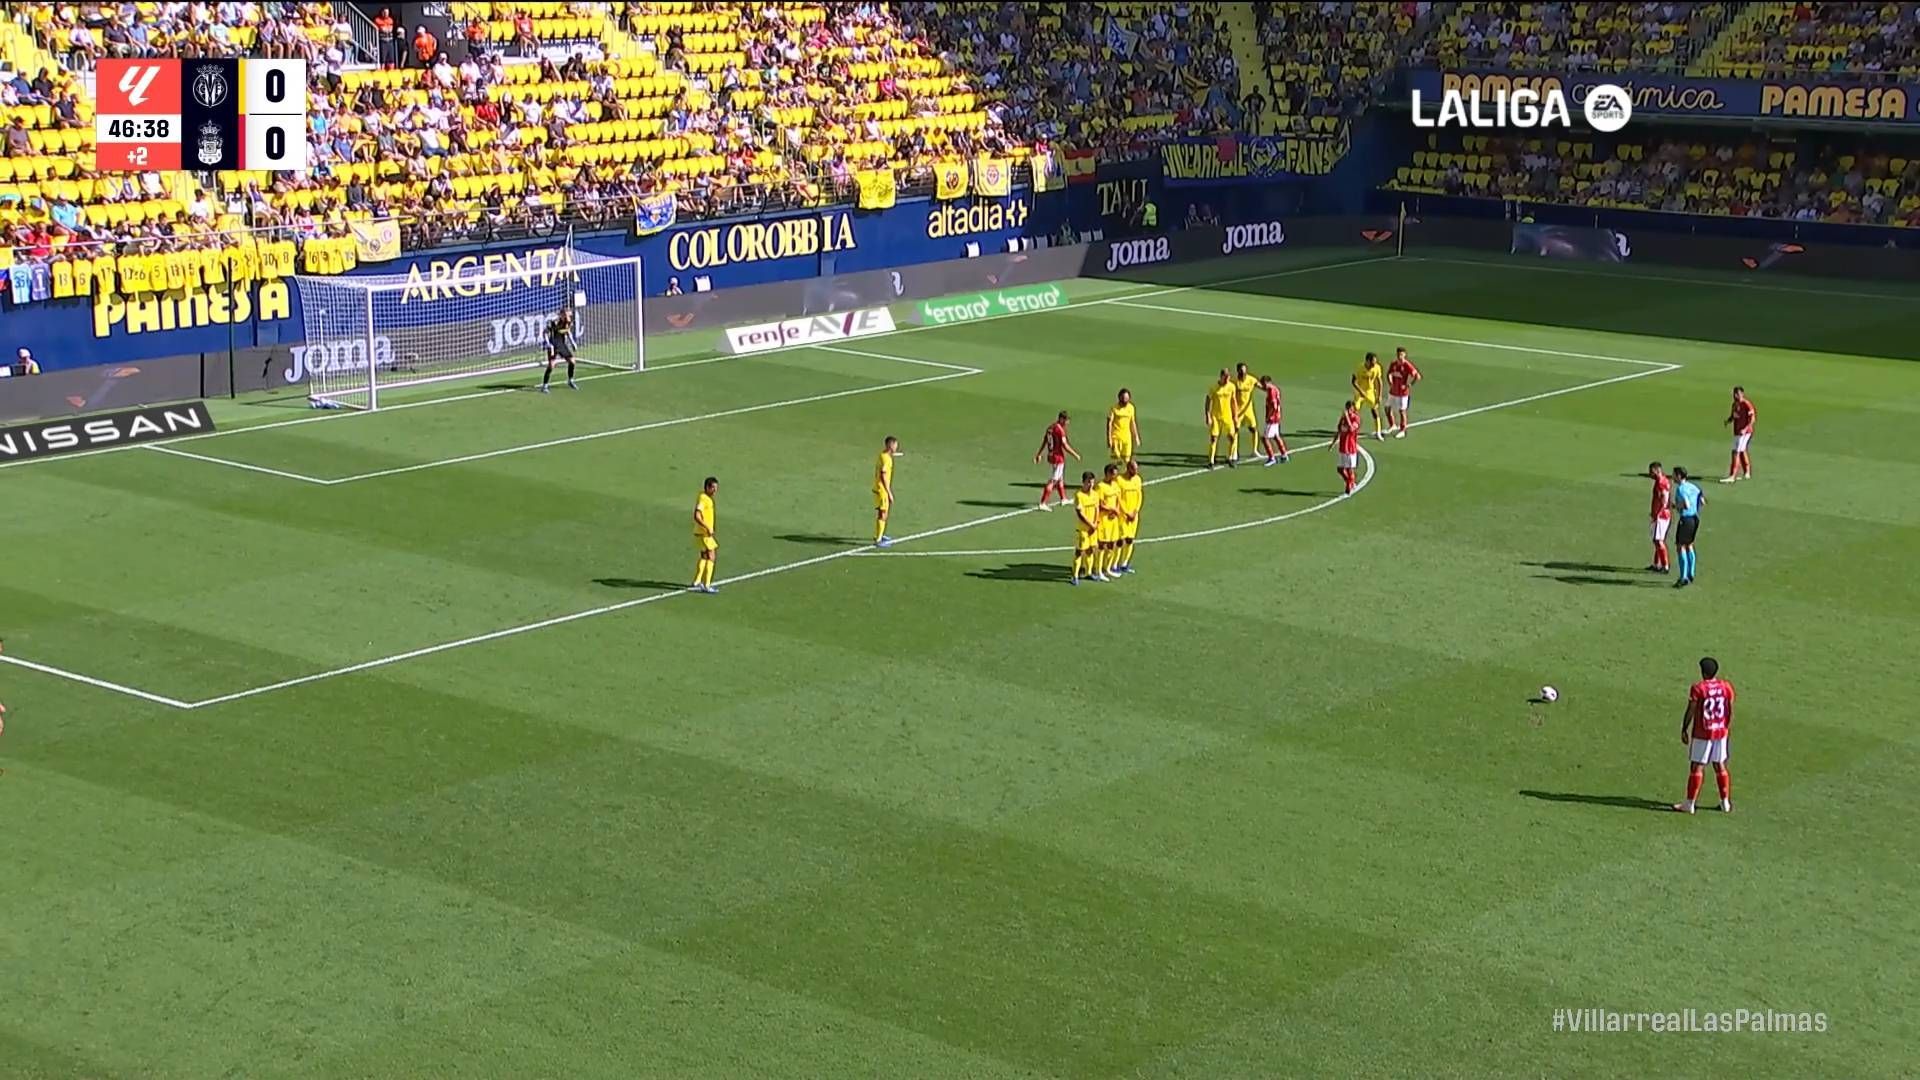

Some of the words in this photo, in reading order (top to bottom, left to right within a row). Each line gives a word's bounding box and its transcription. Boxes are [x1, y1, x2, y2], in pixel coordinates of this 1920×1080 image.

[1761, 85, 1906, 119] PAMESA
[670, 213, 856, 270] COLOROBBIA
[928, 201, 1003, 238] altadia
[400, 246, 581, 304] ARGENTA
[94, 283, 290, 338] PAMESA
[737, 321, 800, 347] renfe
[808, 310, 880, 337] AVE
